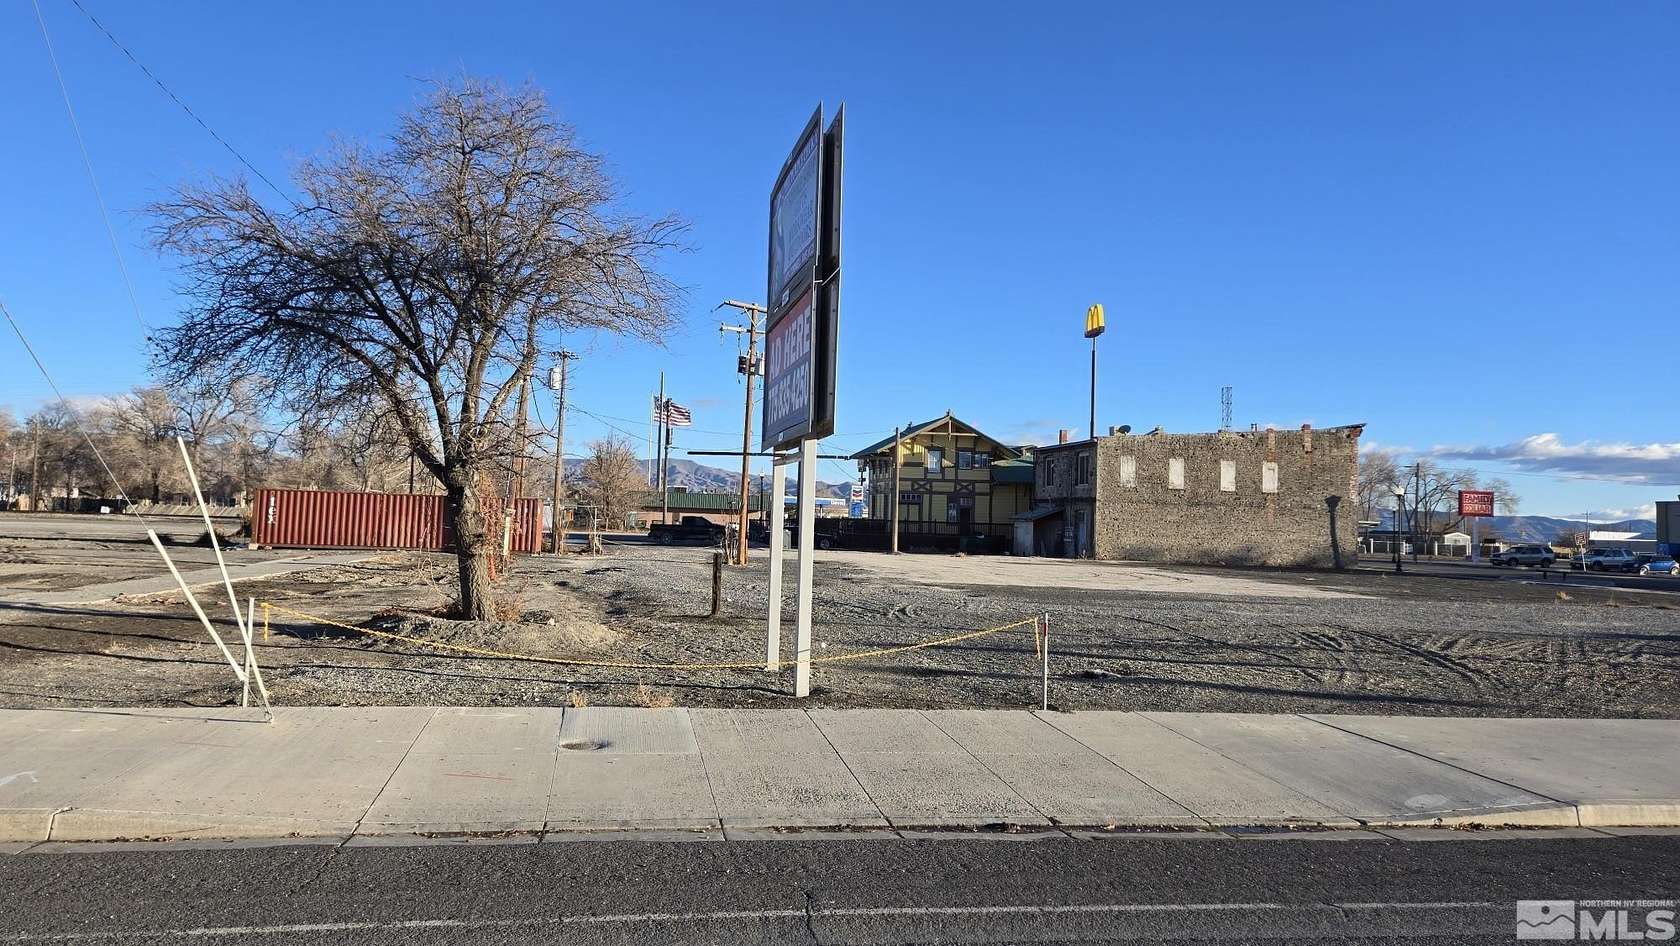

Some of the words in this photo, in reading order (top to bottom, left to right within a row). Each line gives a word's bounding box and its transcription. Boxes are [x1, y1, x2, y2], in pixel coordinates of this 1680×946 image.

[769, 336, 782, 381] AD
[783, 304, 811, 369] HERE
[1463, 493, 1492, 504] FAMILY
